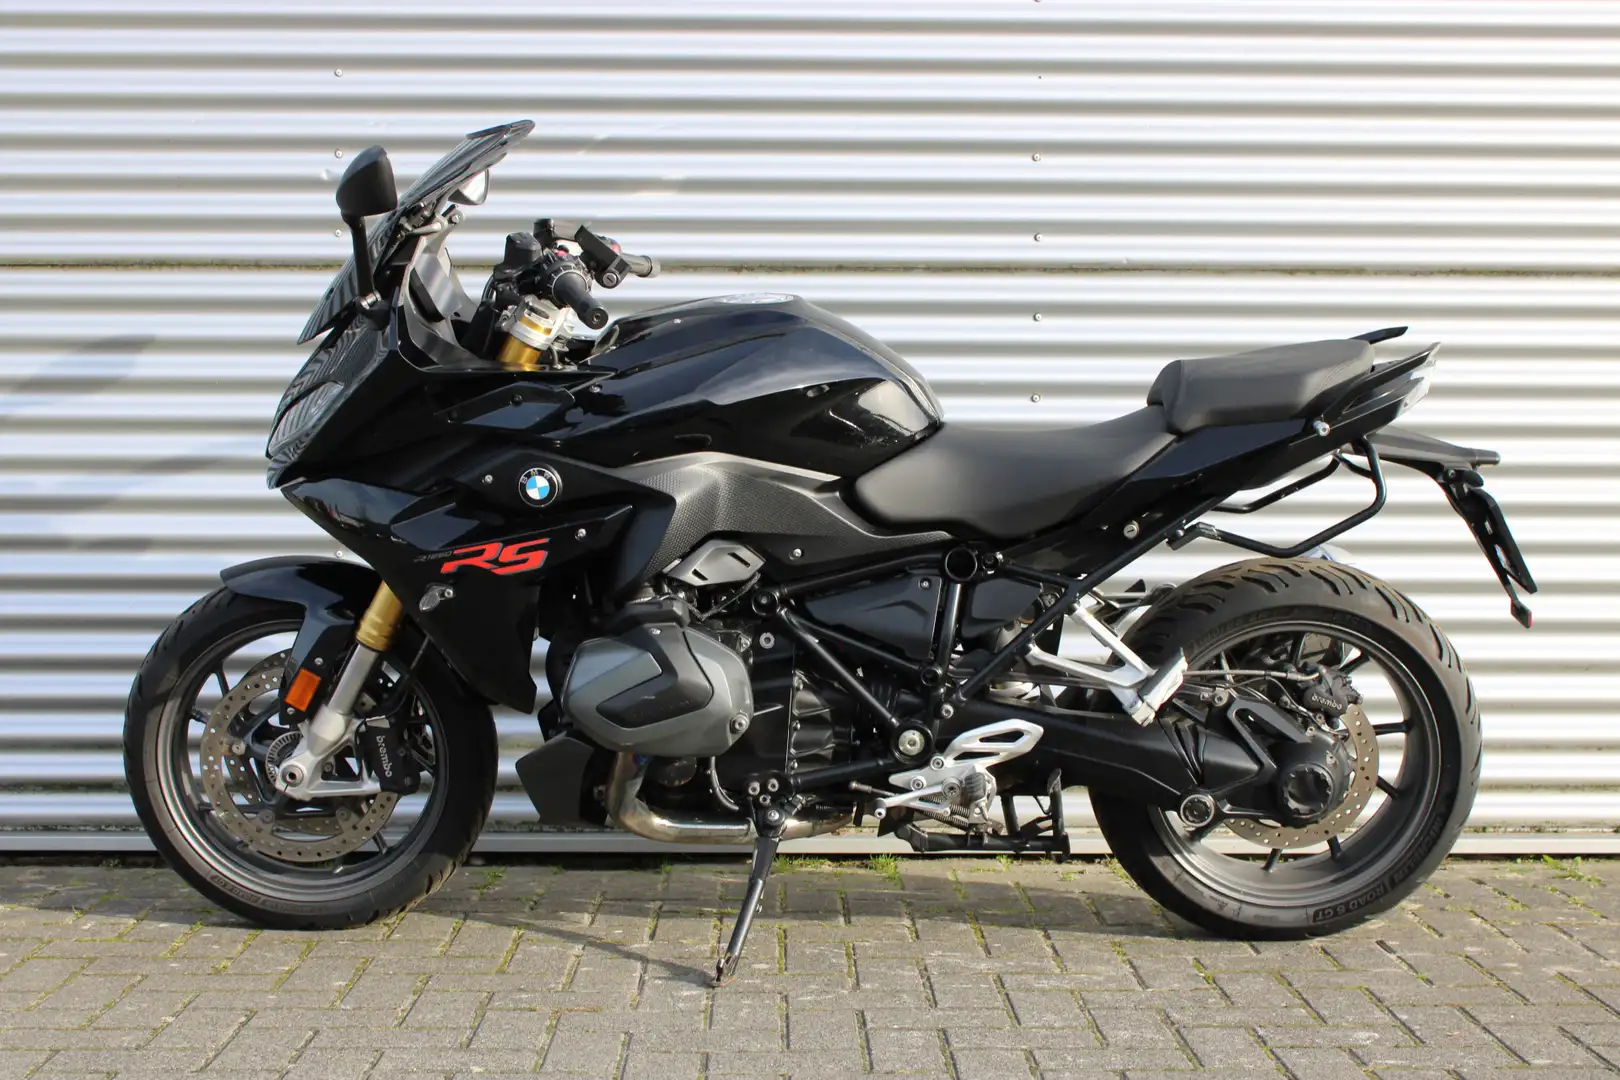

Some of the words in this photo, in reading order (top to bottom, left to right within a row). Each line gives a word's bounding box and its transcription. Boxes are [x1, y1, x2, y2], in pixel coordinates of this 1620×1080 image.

[440, 537, 549, 575] RS
[1311, 692, 1343, 710] brembo
[376, 735, 393, 778] brembo
[1349, 884, 1386, 909] ROAD
[1315, 908, 1334, 921] GT
